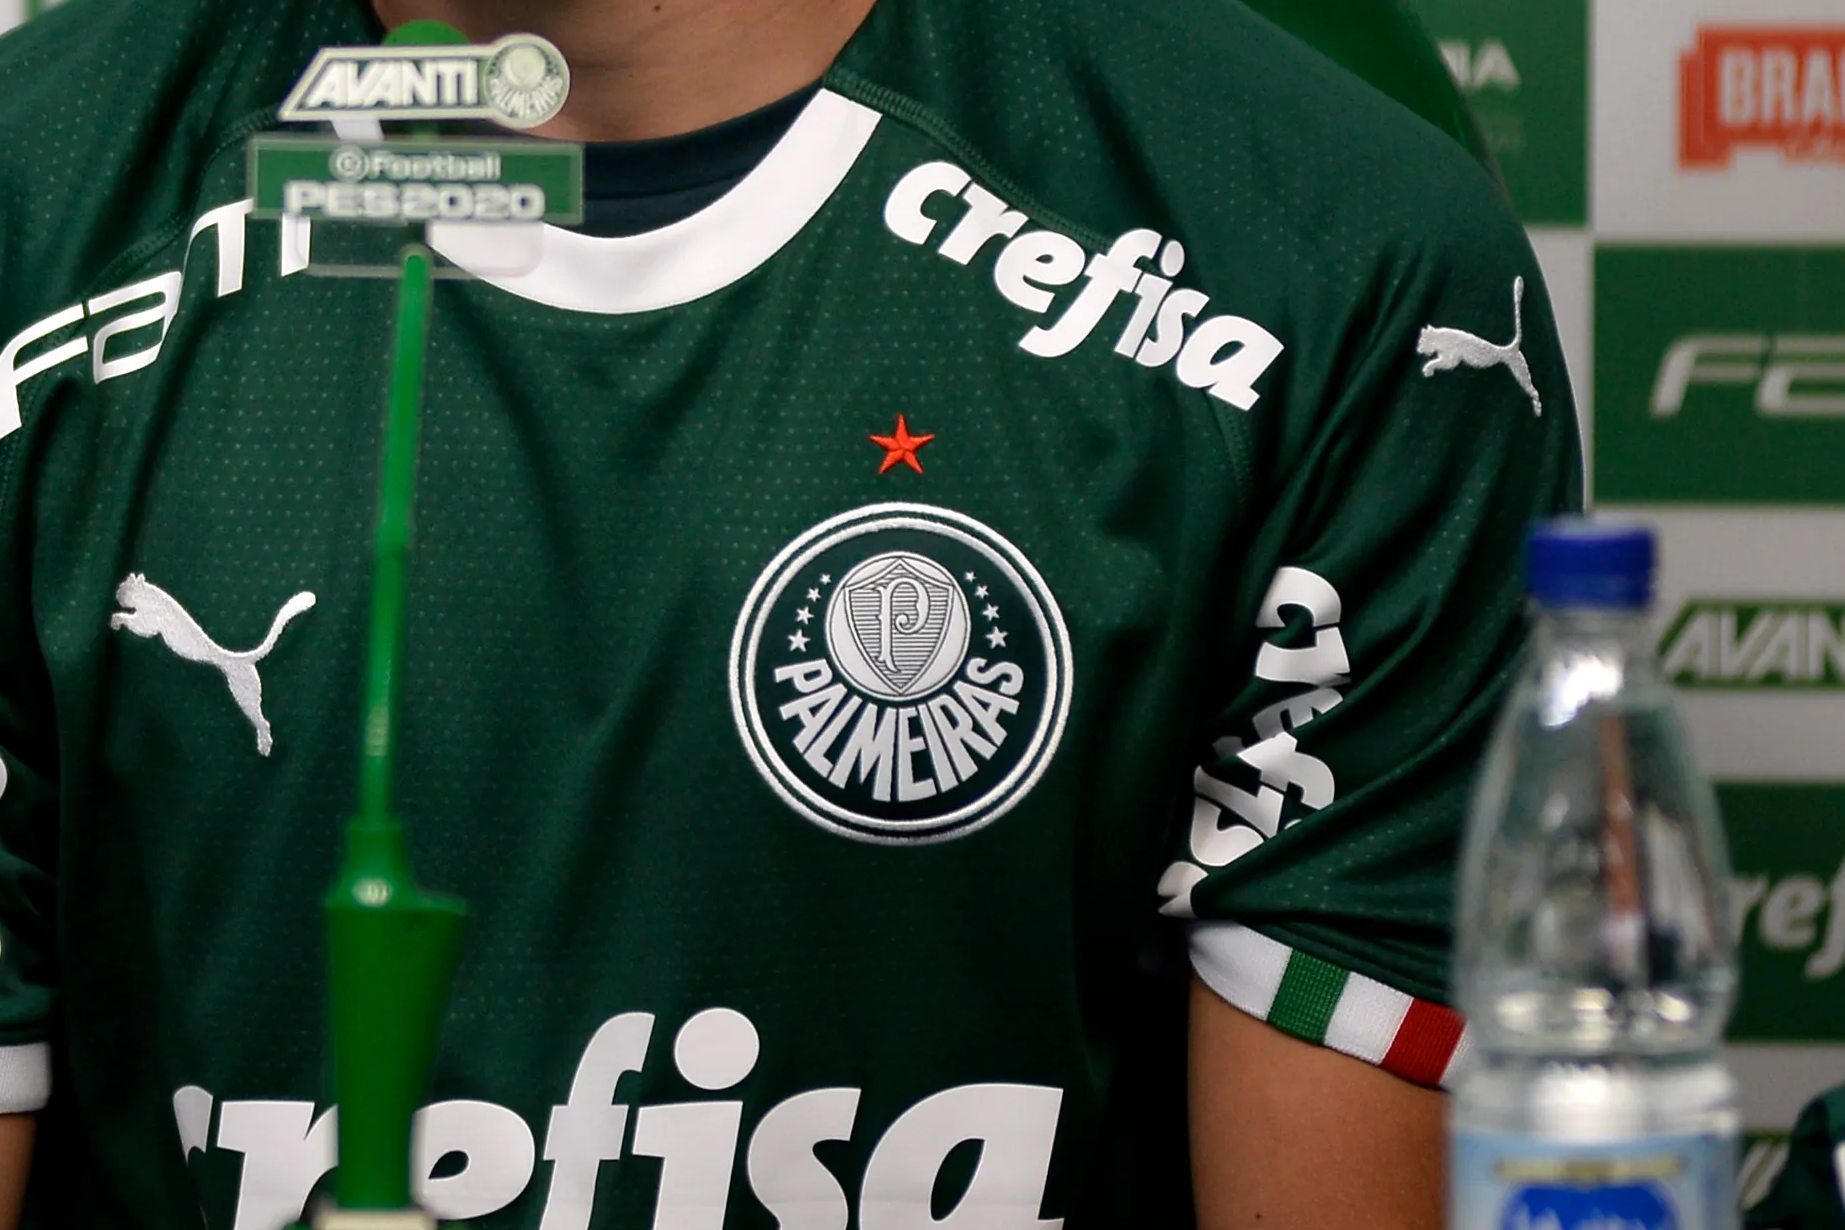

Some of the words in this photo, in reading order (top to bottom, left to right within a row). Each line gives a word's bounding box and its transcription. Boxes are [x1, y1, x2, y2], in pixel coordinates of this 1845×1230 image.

[305, 58, 478, 108] AVANTI
[1718, 46, 1845, 126] BRA
[883, 156, 1284, 412] crefisa
[1652, 337, 1845, 415] Fa
[1663, 608, 1845, 680] AVAN
[774, 655, 1025, 803] PALMEIRAS
